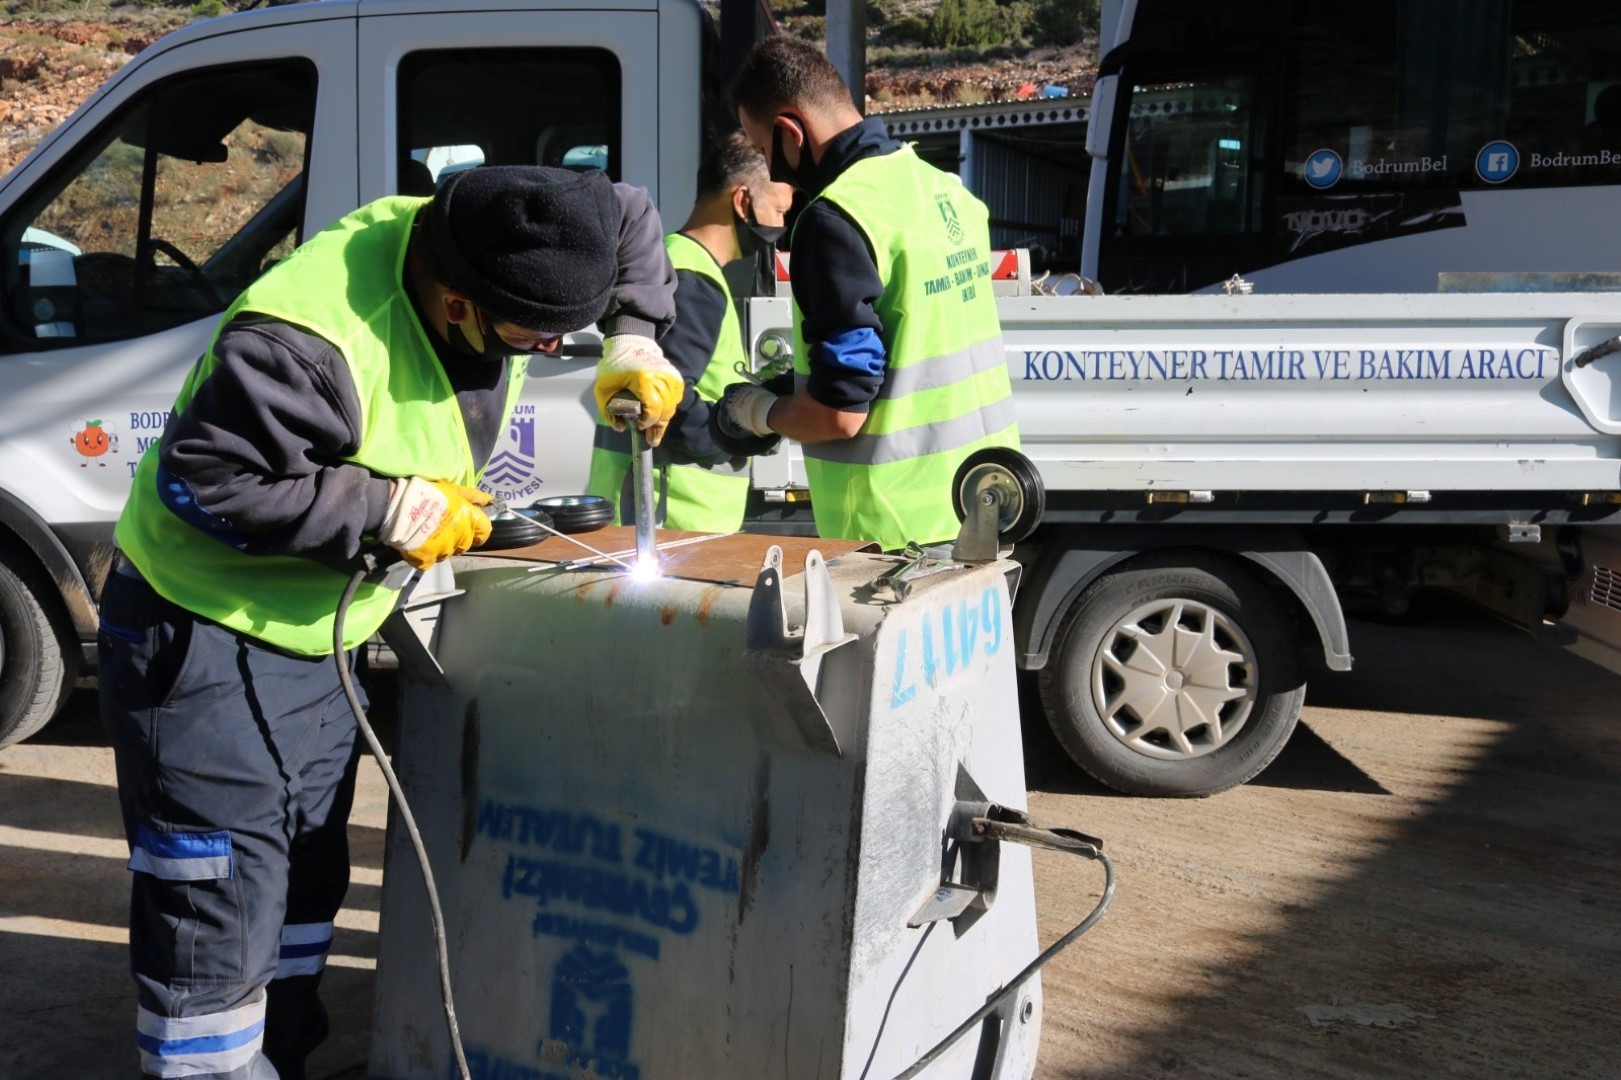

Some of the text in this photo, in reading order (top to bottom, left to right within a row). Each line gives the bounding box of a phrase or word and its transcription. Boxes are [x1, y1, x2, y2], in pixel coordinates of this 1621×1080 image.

[1352, 155, 1447, 174] BodrumBel
[1023, 345, 1546, 381] KONTEYNER TAMİR VE BAKIM ARACI
